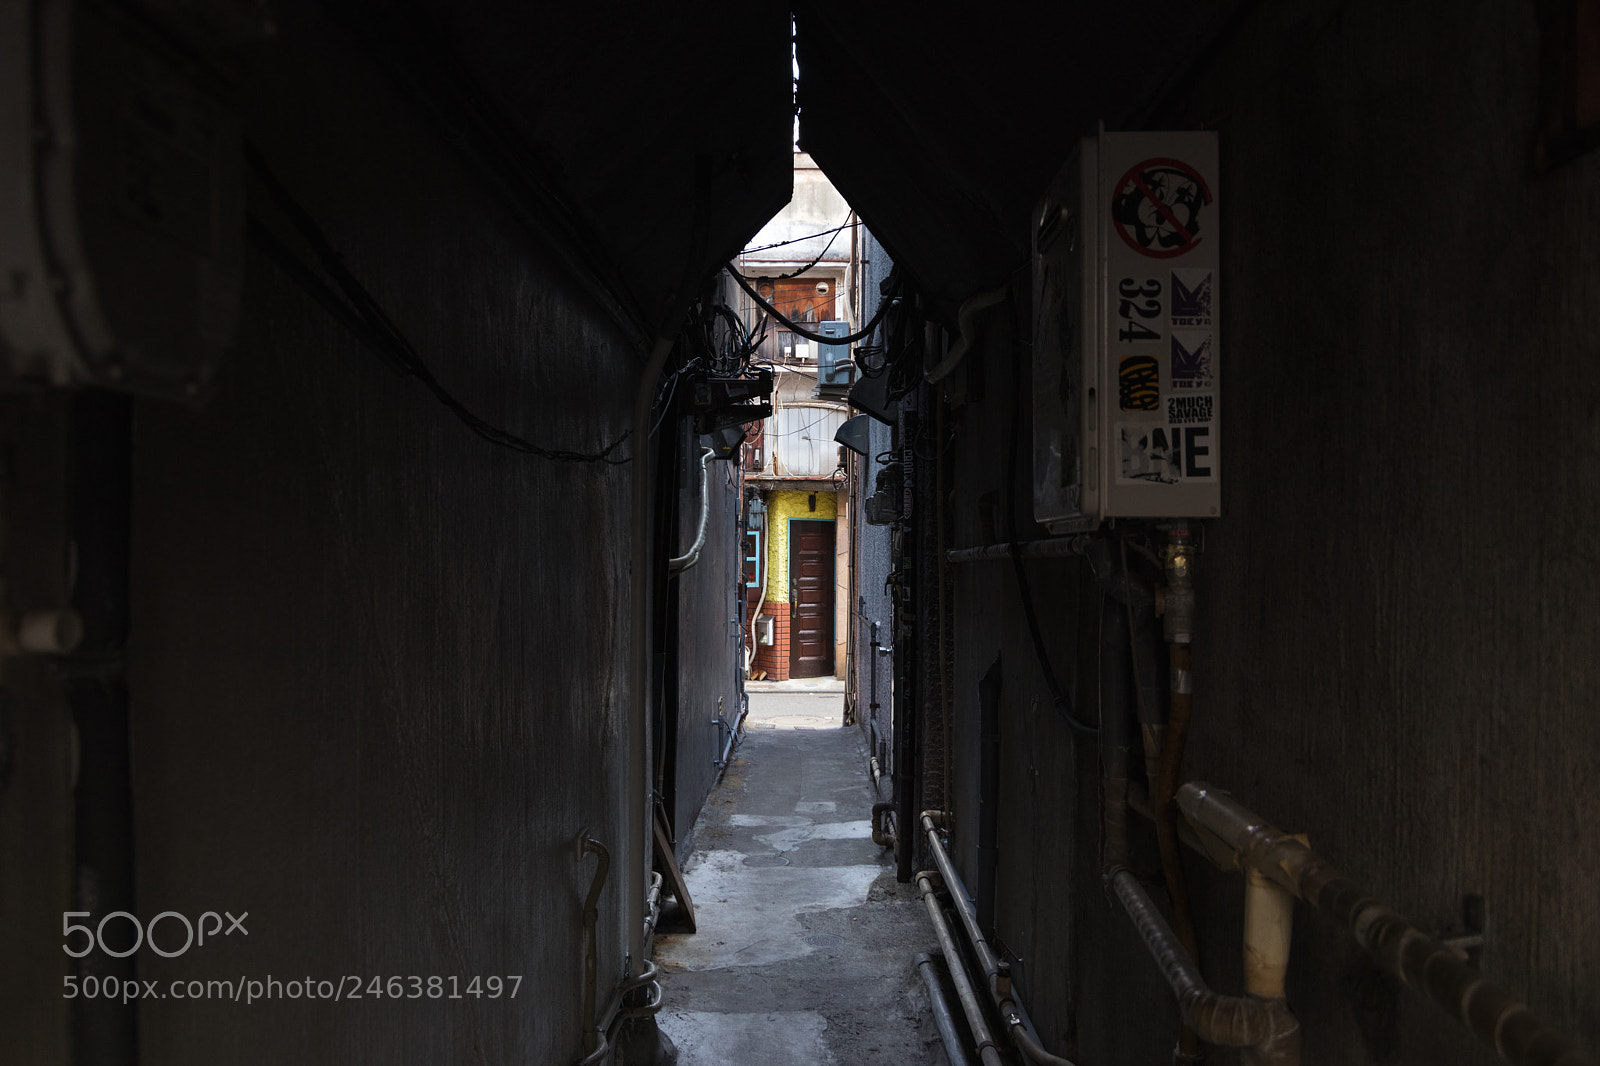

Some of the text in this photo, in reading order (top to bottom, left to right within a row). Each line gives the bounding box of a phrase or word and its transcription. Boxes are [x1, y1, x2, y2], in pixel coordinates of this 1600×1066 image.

[1119, 277, 1162, 343] 324
[1168, 395, 1213, 409] 2MUCH
[1168, 407, 1214, 419] SAVAGE
